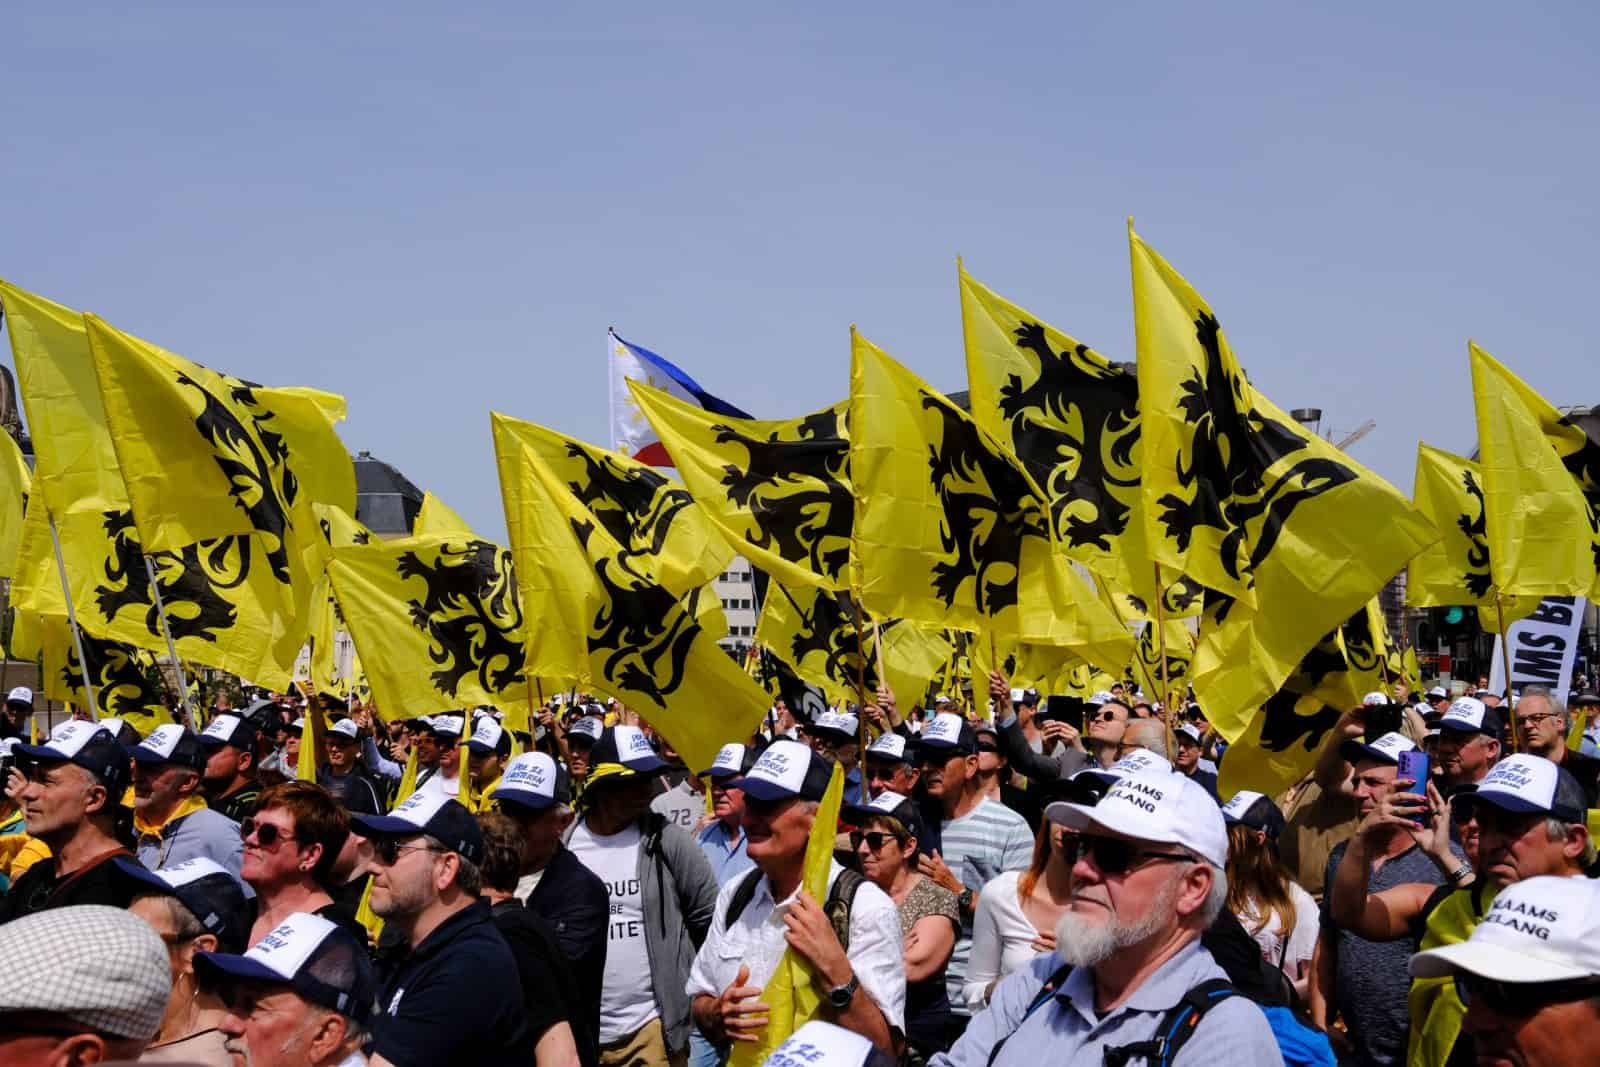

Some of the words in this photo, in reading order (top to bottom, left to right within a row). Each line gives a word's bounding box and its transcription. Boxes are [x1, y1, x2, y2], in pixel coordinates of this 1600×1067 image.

[1116, 780, 1164, 801] LAAMS
[1106, 790, 1156, 813] ELANG
[670, 808, 691, 826] 72
[605, 880, 640, 897] OUD
[1493, 899, 1558, 923] LAAMS
[610, 921, 639, 940] ITE
[1485, 914, 1550, 941] ELANG
